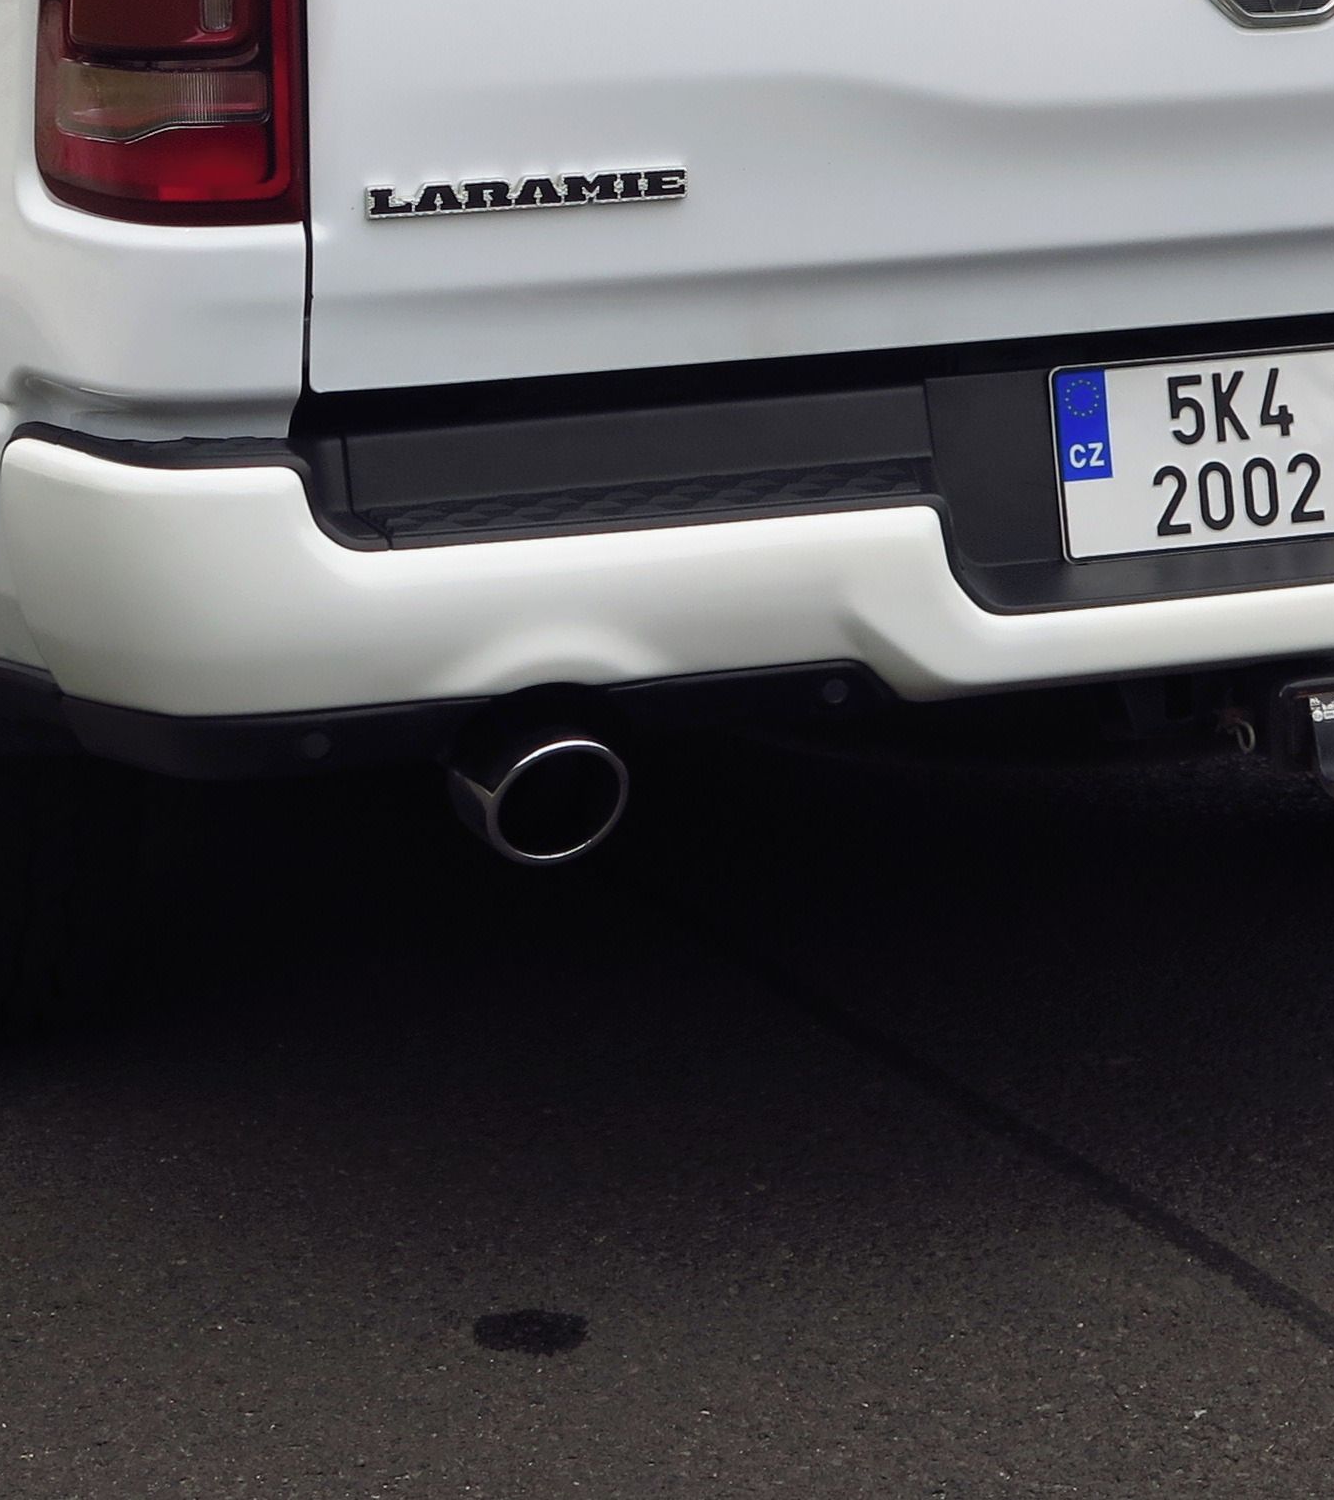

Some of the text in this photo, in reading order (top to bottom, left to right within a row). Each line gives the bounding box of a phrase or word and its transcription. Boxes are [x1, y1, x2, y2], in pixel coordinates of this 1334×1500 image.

[366, 166, 688, 220] LARAMIE
[1166, 366, 1295, 446] 5K4
[1068, 441, 1106, 470] CZ
[1152, 452, 1326, 538] 2002
